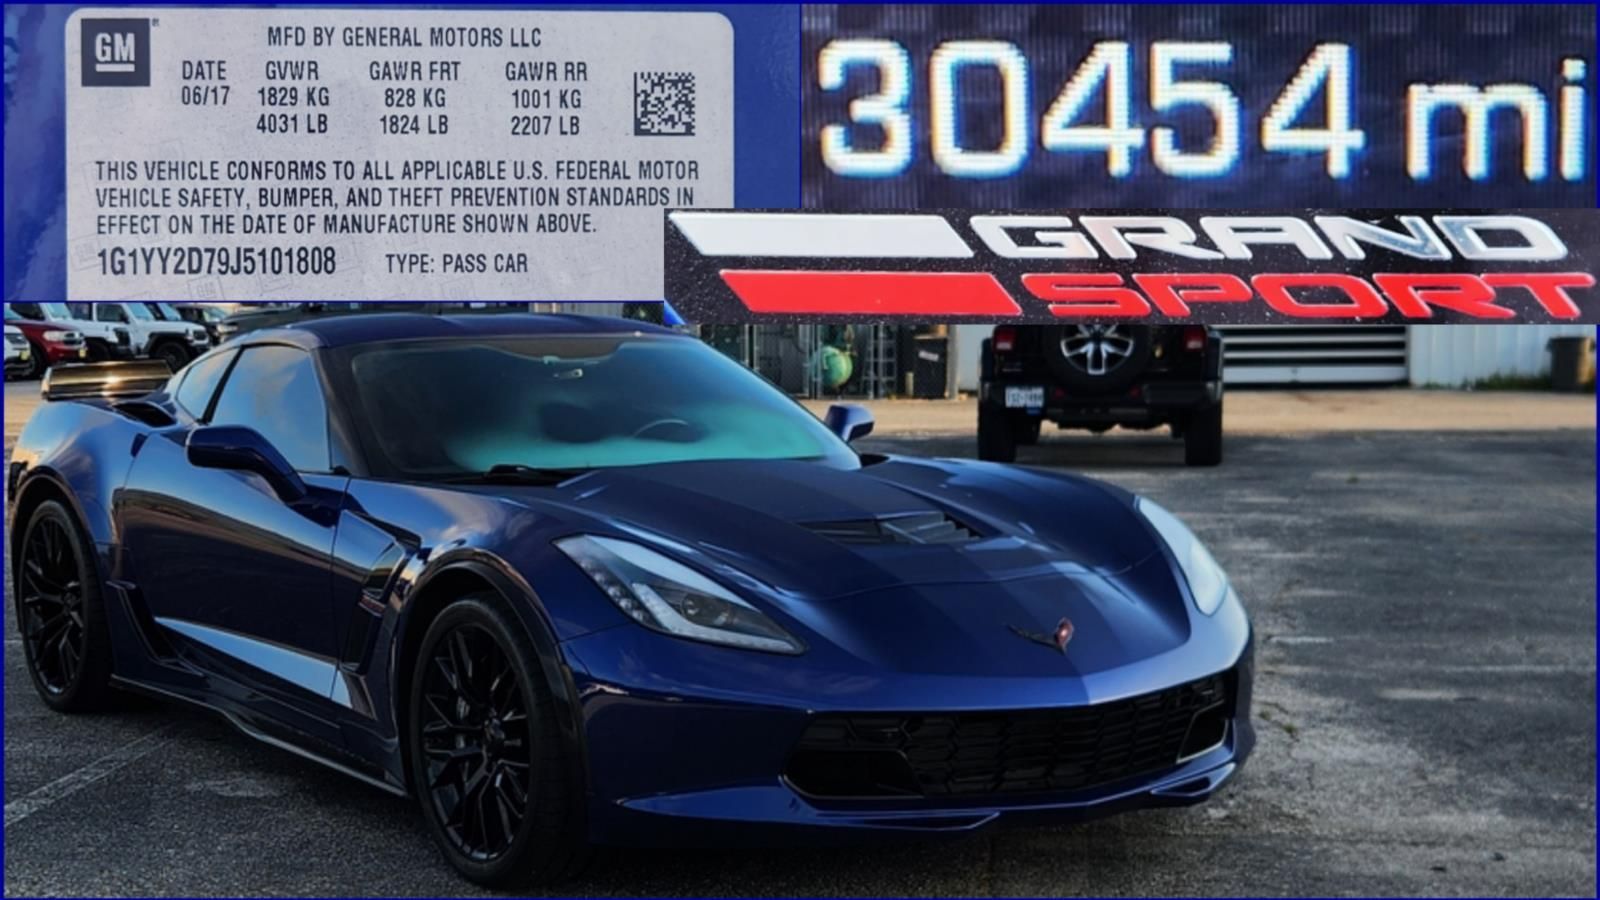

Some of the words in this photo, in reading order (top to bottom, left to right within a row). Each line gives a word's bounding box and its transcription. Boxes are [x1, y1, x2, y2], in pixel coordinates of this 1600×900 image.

[268, 27, 305, 46] MFD
[314, 27, 334, 46] BY
[343, 27, 422, 46] GENERAL
[430, 27, 502, 47] MOTORS
[511, 28, 541, 47] LLC
[95, 32, 135, 62] GM
[182, 61, 226, 80] DATE
[266, 61, 319, 80] GVWR
[369, 61, 422, 80] GAWR
[430, 61, 461, 80] FRT
[506, 62, 557, 81] GAWR
[565, 62, 588, 81] RR
[181, 86, 230, 105] 06/17
[258, 87, 298, 106] 1829
[307, 87, 329, 106] KG
[385, 88, 415, 107] 828
[424, 88, 446, 107] KG
[512, 89, 550, 108] 1001
[560, 89, 582, 108] KG
[817, 38, 1366, 178] 30454
[1406, 57, 1587, 180] mi
[257, 114, 297, 133] 4031
[307, 114, 327, 133] LB
[380, 115, 420, 134] 1824
[428, 115, 448, 134] LB
[511, 116, 551, 135] 2207
[560, 116, 580, 135] LB
[96, 161, 137, 180] THIS
[144, 161, 219, 180] VEHICLE
[228, 160, 326, 180] CONFORMS
[333, 161, 354, 180] TO
[363, 161, 394, 180] ALL
[402, 161, 505, 180] APPLICABLE
[513, 161, 548, 180] U.S.
[556, 160, 631, 179] FEDERAL
[639, 161, 699, 179] MOTOR
[96, 188, 170, 207] VEHICLE
[179, 188, 250, 210] SAFETY,
[259, 187, 338, 210] BUMPER,
[346, 187, 382, 207] AND
[388, 187, 443, 206] THEFT
[452, 187, 559, 206] PREVENTION
[567, 187, 670, 206] STANDARDS
[677, 187, 694, 206] IN
[98, 215, 160, 234] EFFECT
[169, 215, 192, 234] ON
[201, 215, 234, 234] THE
[243, 214, 286, 233] DATE
[294, 214, 315, 233] OF
[324, 214, 455, 233] MANUFACTURE
[463, 214, 528, 233] SHOWN
[536, 214, 597, 232] ABOVE.
[969, 215, 1569, 259] GRAND
[97, 246, 336, 275] 1G1YY2D79J5101808
[386, 254, 434, 273] TYPE:
[443, 254, 486, 272] PASS
[495, 253, 528, 272] CAR
[1020, 272, 1596, 318] SPORT
